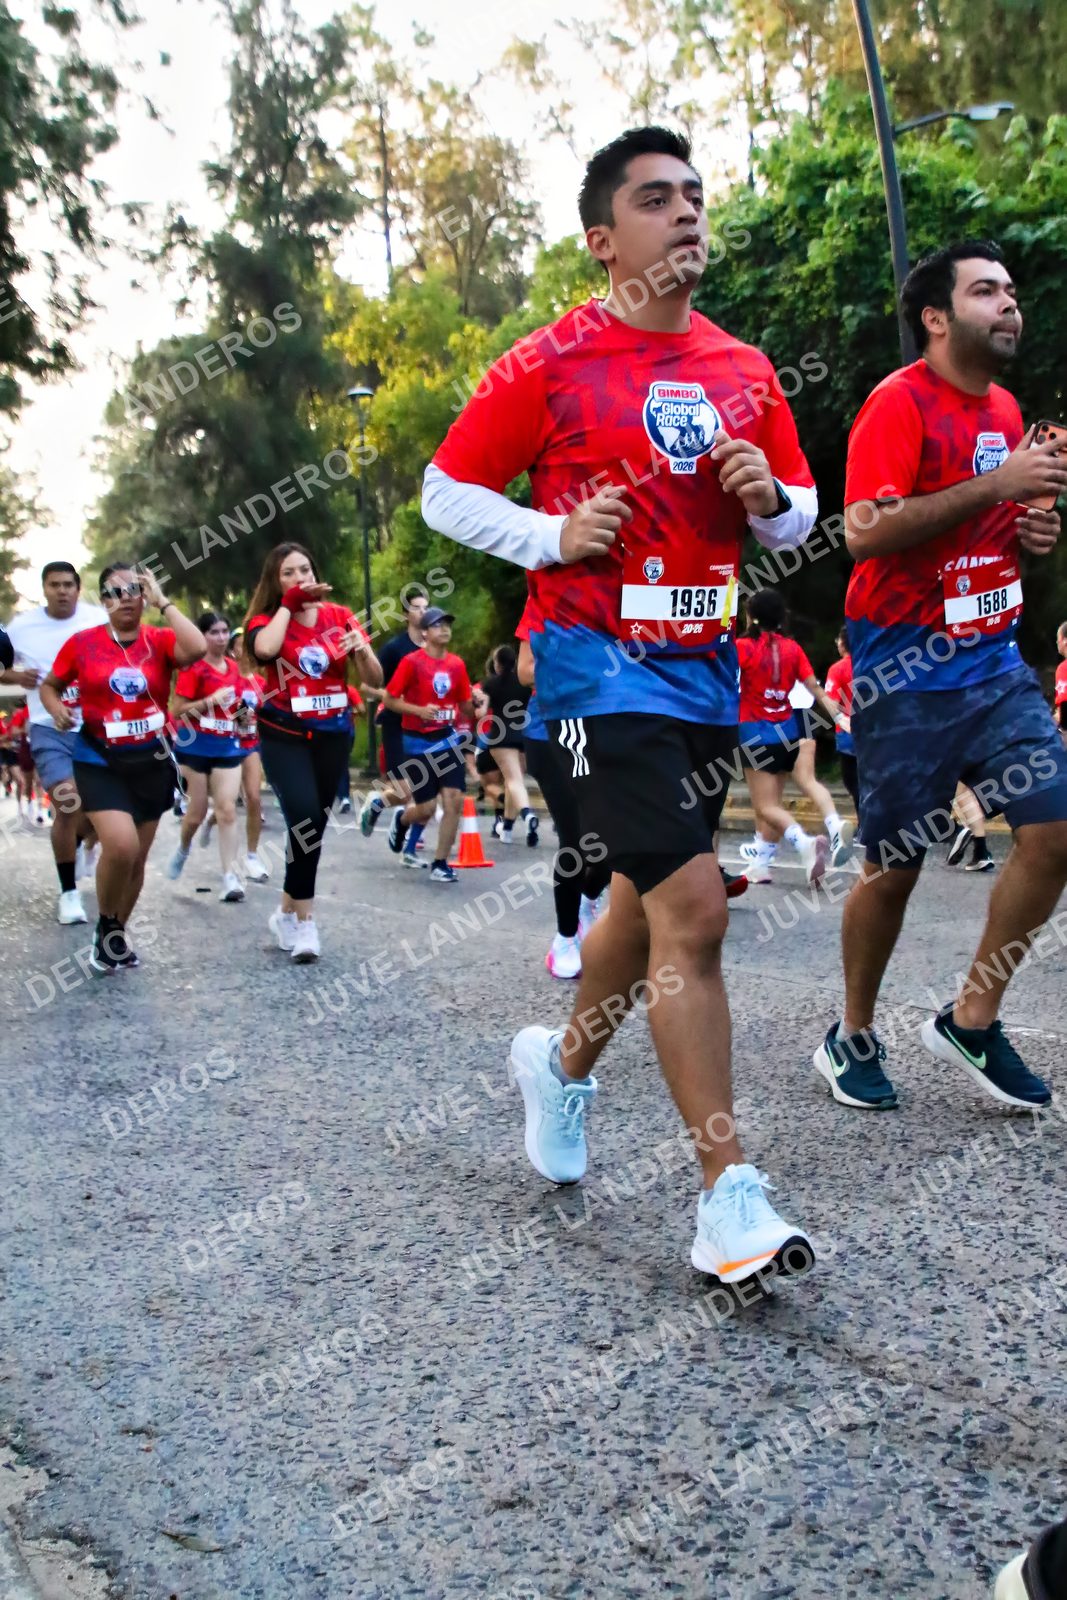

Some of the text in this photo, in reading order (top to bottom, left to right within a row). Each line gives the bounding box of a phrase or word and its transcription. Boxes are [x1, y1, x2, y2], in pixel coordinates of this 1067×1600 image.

[658, 389, 698, 398] BIMBO
[661, 402, 700, 416] Global
[656, 413, 688, 427] Race
[672, 461, 695, 472] 2026
[670, 588, 718, 618] 1936
[976, 588, 1008, 617] 1588
[312, 696, 332, 710] 2112
[127, 720, 149, 735] 2113
